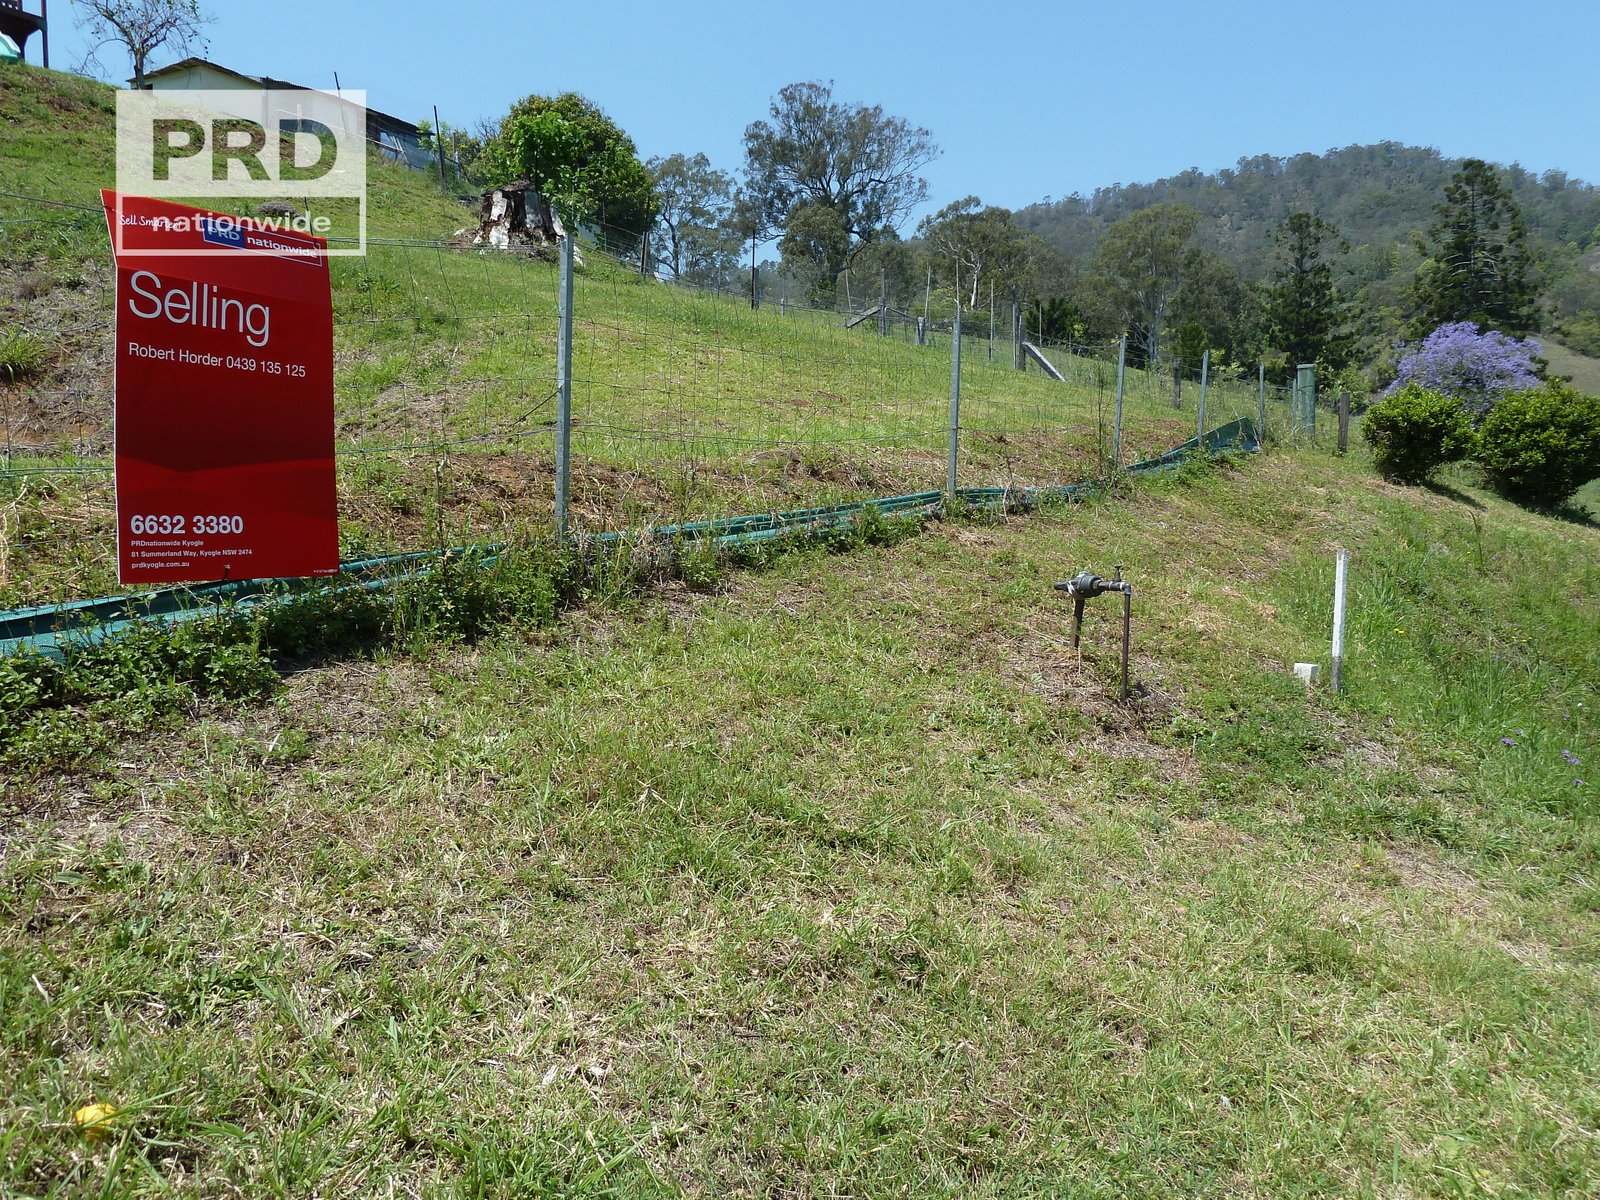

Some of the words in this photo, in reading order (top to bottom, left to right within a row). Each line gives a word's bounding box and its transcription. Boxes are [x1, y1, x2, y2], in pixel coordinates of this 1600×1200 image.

[119, 214, 138, 226] Sell
[208, 225, 240, 241] PRD
[246, 234, 318, 259] nationwide
[129, 270, 270, 347] Selling
[129, 342, 175, 361] Robert
[179, 350, 223, 367] Horder
[226, 356, 257, 371] 0439
[260, 360, 282, 375] 135
[285, 363, 306, 378] 125
[130, 514, 186, 535] 6632
[192, 515, 244, 535] 3380
[182, 539, 204, 548] Kyogle
[183, 549, 199, 557] Way,
[200, 549, 222, 557] Kyogle
[222, 548, 237, 556] NSW
[238, 548, 253, 556] 2474
[131, 561, 190, 570] prdkyogle.com.au
